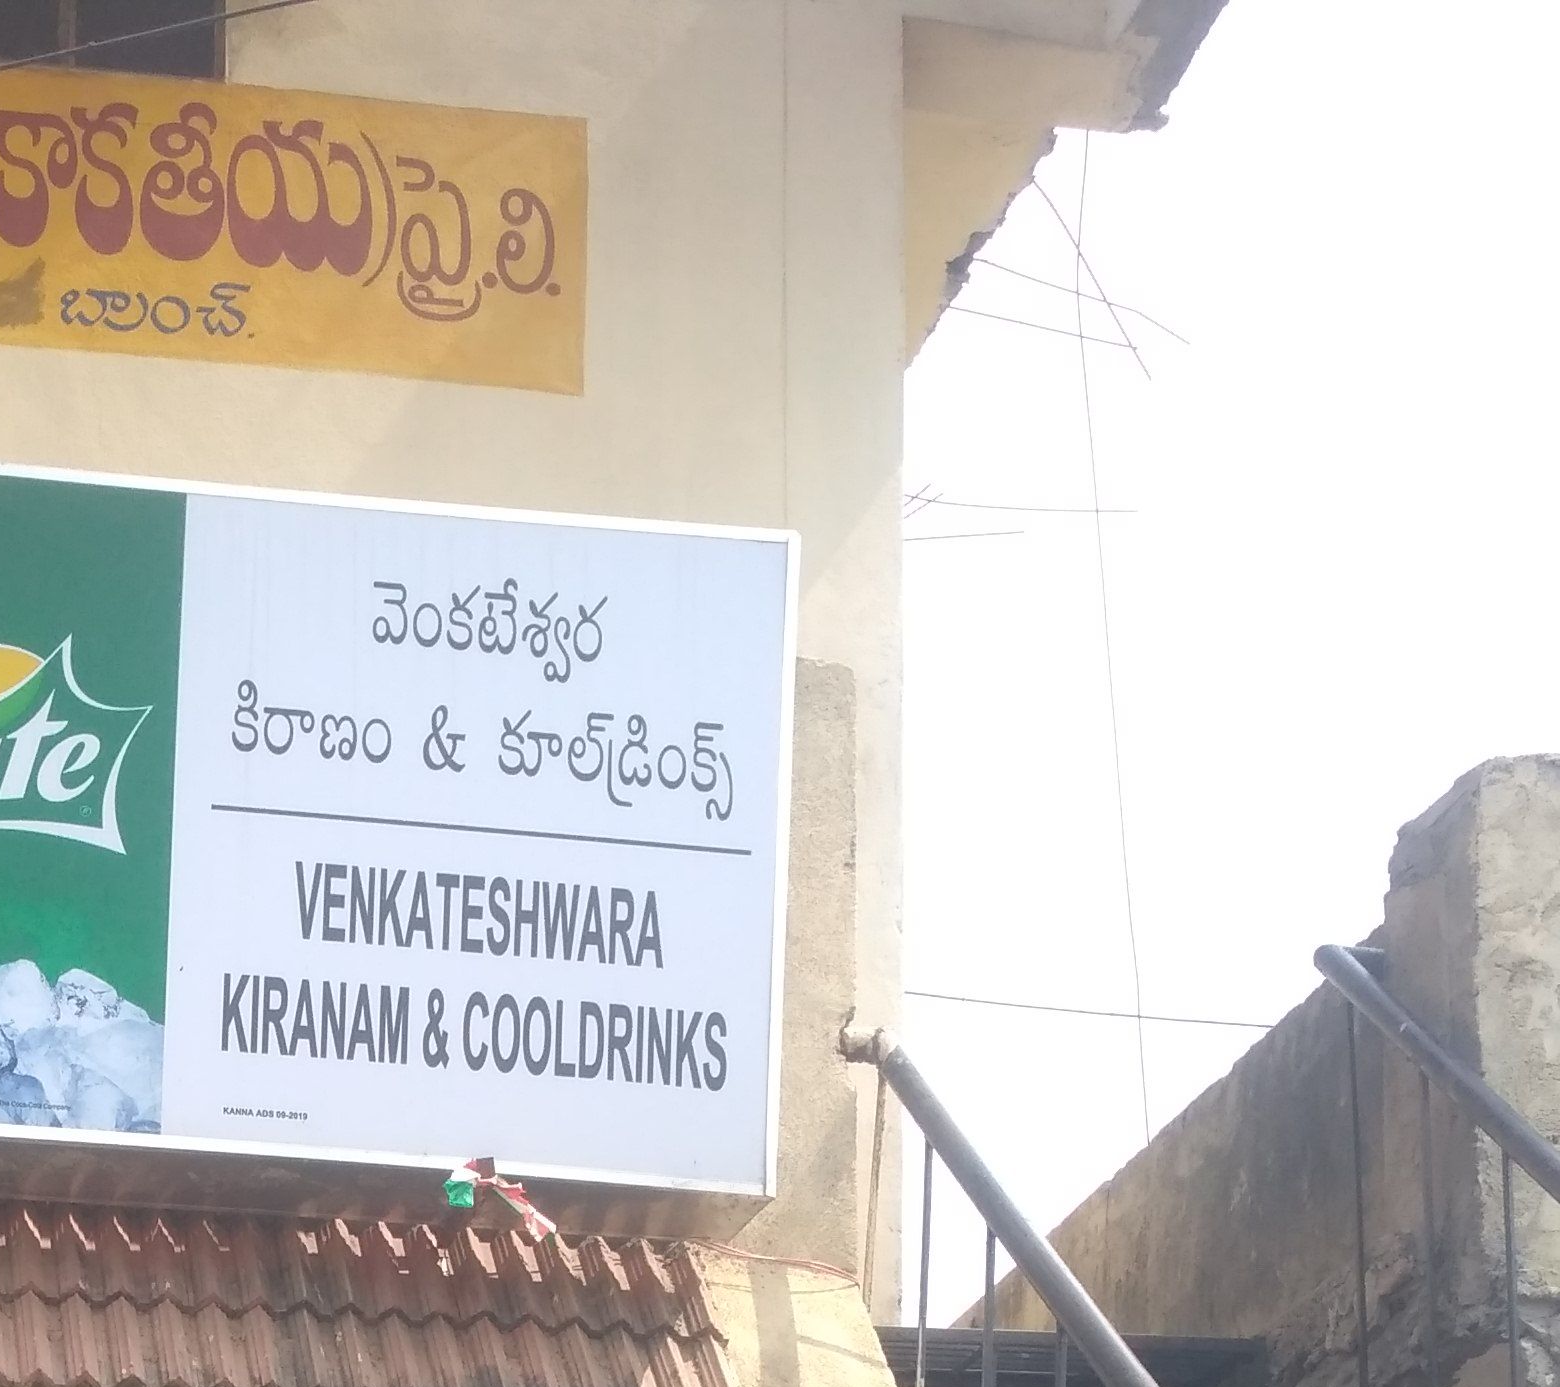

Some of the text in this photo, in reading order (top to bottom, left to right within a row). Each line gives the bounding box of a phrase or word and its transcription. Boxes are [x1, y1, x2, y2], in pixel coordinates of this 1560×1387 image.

[373, 578, 608, 683] వెంకటేశ్వర
[231, 679, 392, 763] కిరాణం
[422, 704, 466, 773] &
[295, 861, 664, 969] VENKATESHWARA
[221, 972, 727, 1091] KIRANAM & COOLDRINKS
[223, 1107, 254, 1117] KANNA
[256, 1109, 274, 1118] ADS
